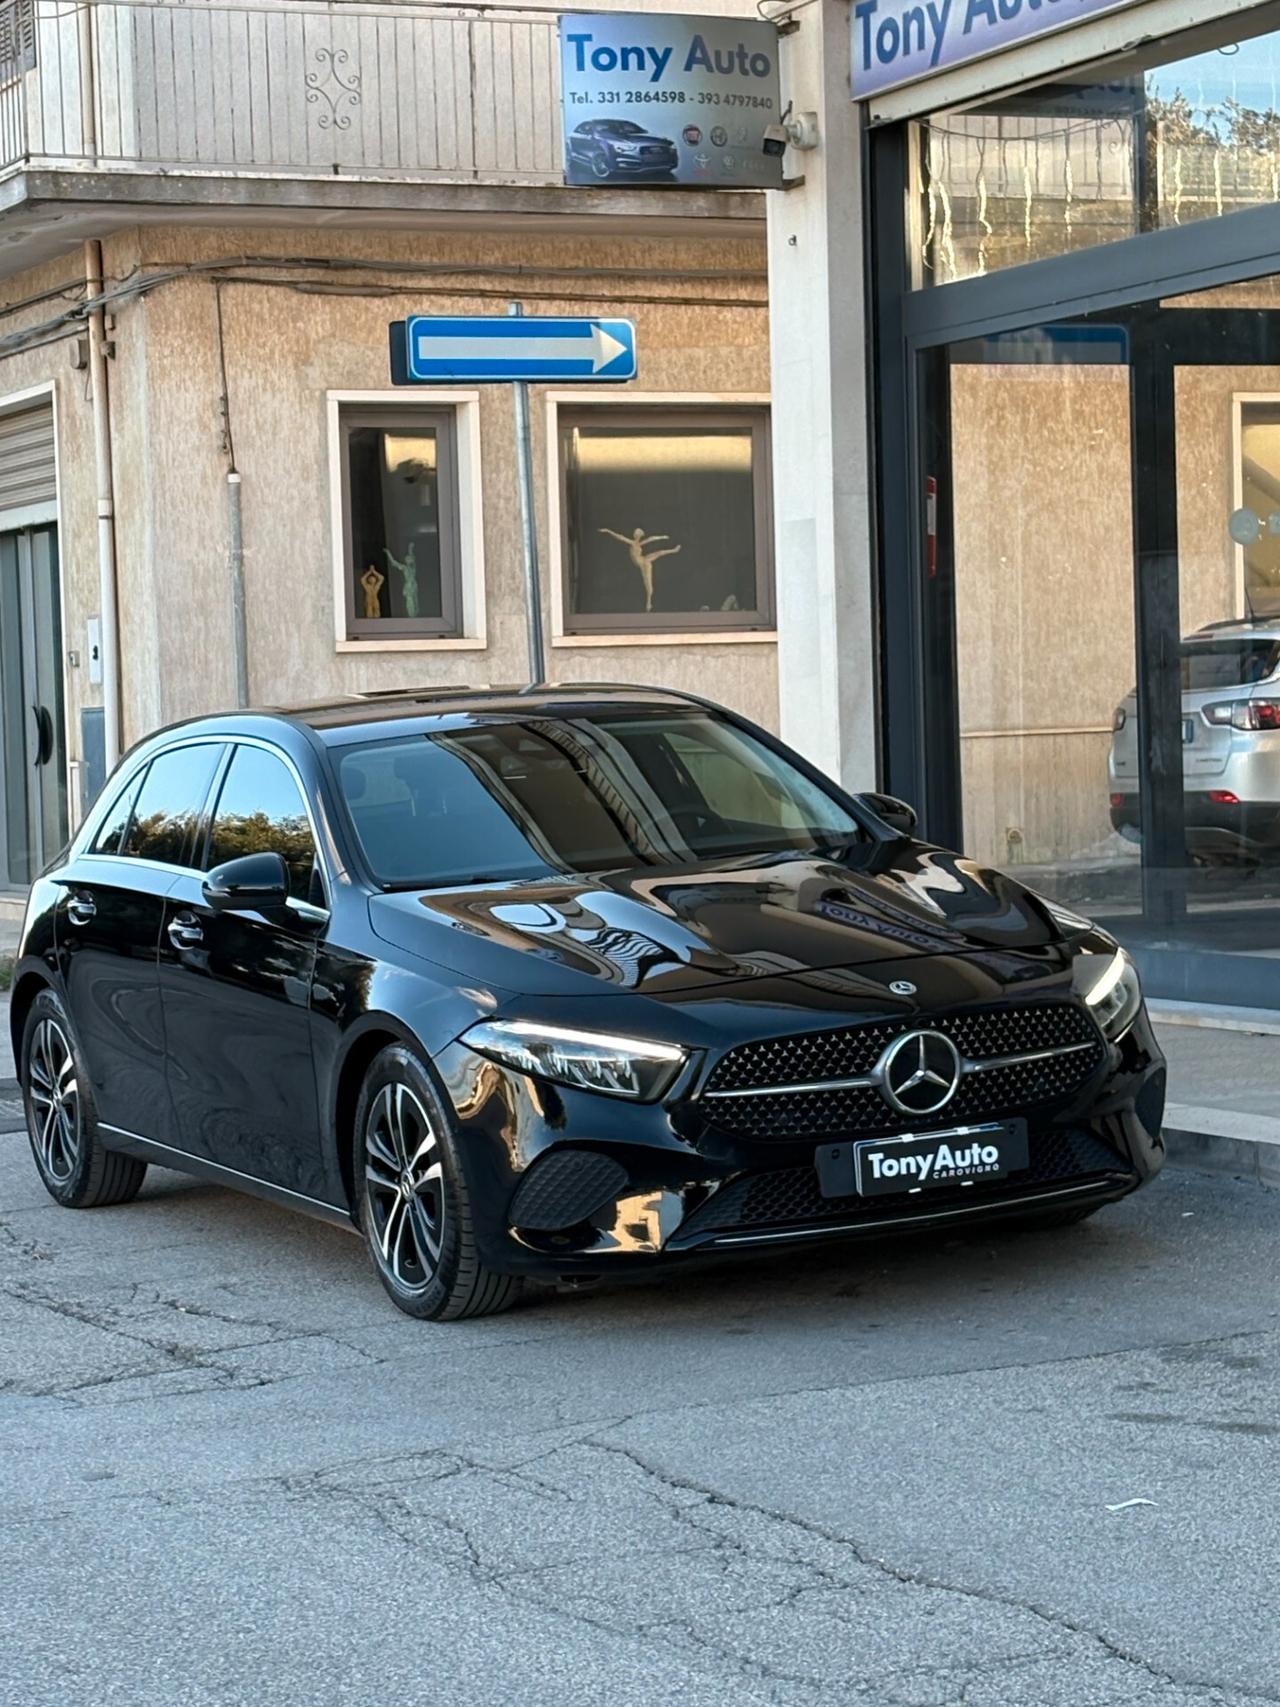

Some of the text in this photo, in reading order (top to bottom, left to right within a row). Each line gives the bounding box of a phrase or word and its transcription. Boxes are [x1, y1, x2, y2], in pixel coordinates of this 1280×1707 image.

[855, 0, 952, 70] Tony
[567, 33, 771, 82] Tony Auto
[569, 91, 593, 104] Tel.
[598, 91, 620, 104] 331
[625, 91, 686, 104] 2864598
[698, 92, 721, 106] 393
[723, 94, 773, 109] 4797840
[933, 1163, 1000, 1180] CAROVIGNO
